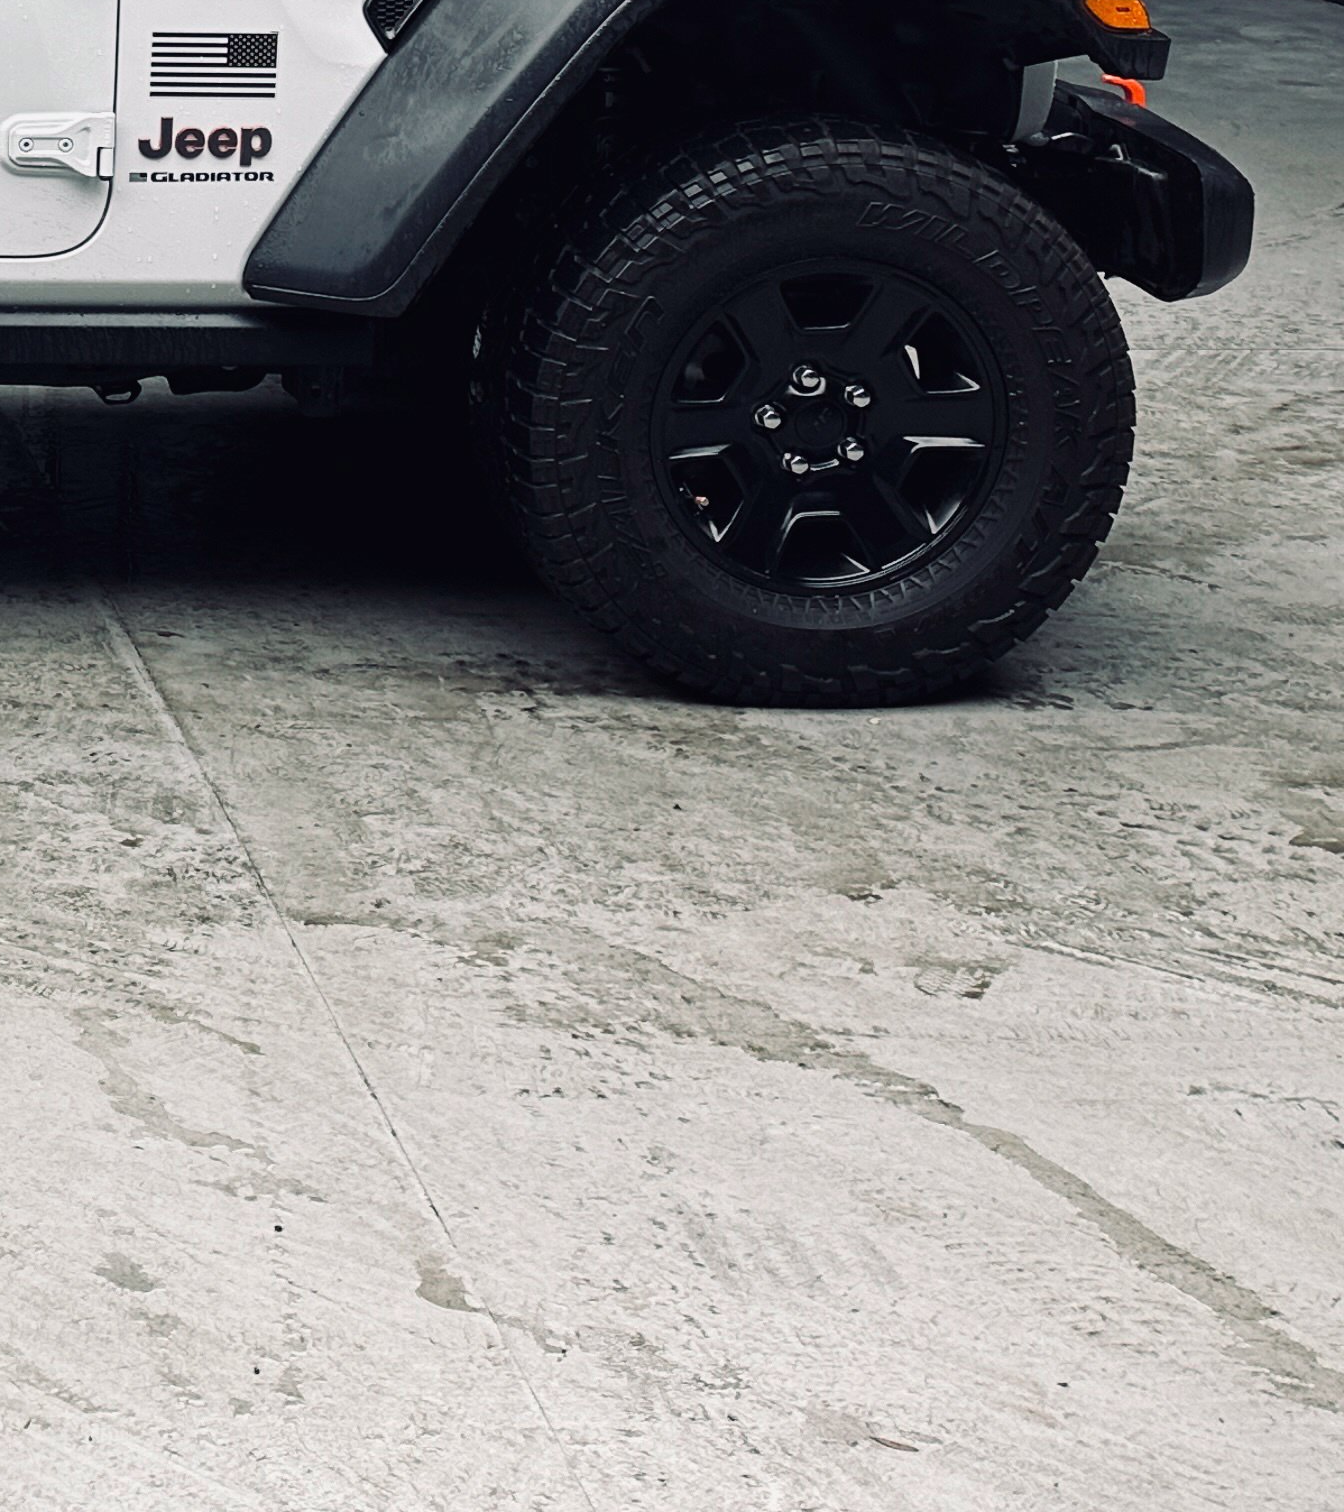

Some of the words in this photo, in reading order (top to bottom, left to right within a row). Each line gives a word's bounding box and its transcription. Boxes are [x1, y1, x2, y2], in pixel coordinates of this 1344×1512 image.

[138, 116, 273, 167] Jeep
[150, 171, 275, 183] GLADIATOR
[856, 200, 1082, 450] WILDPEAK
